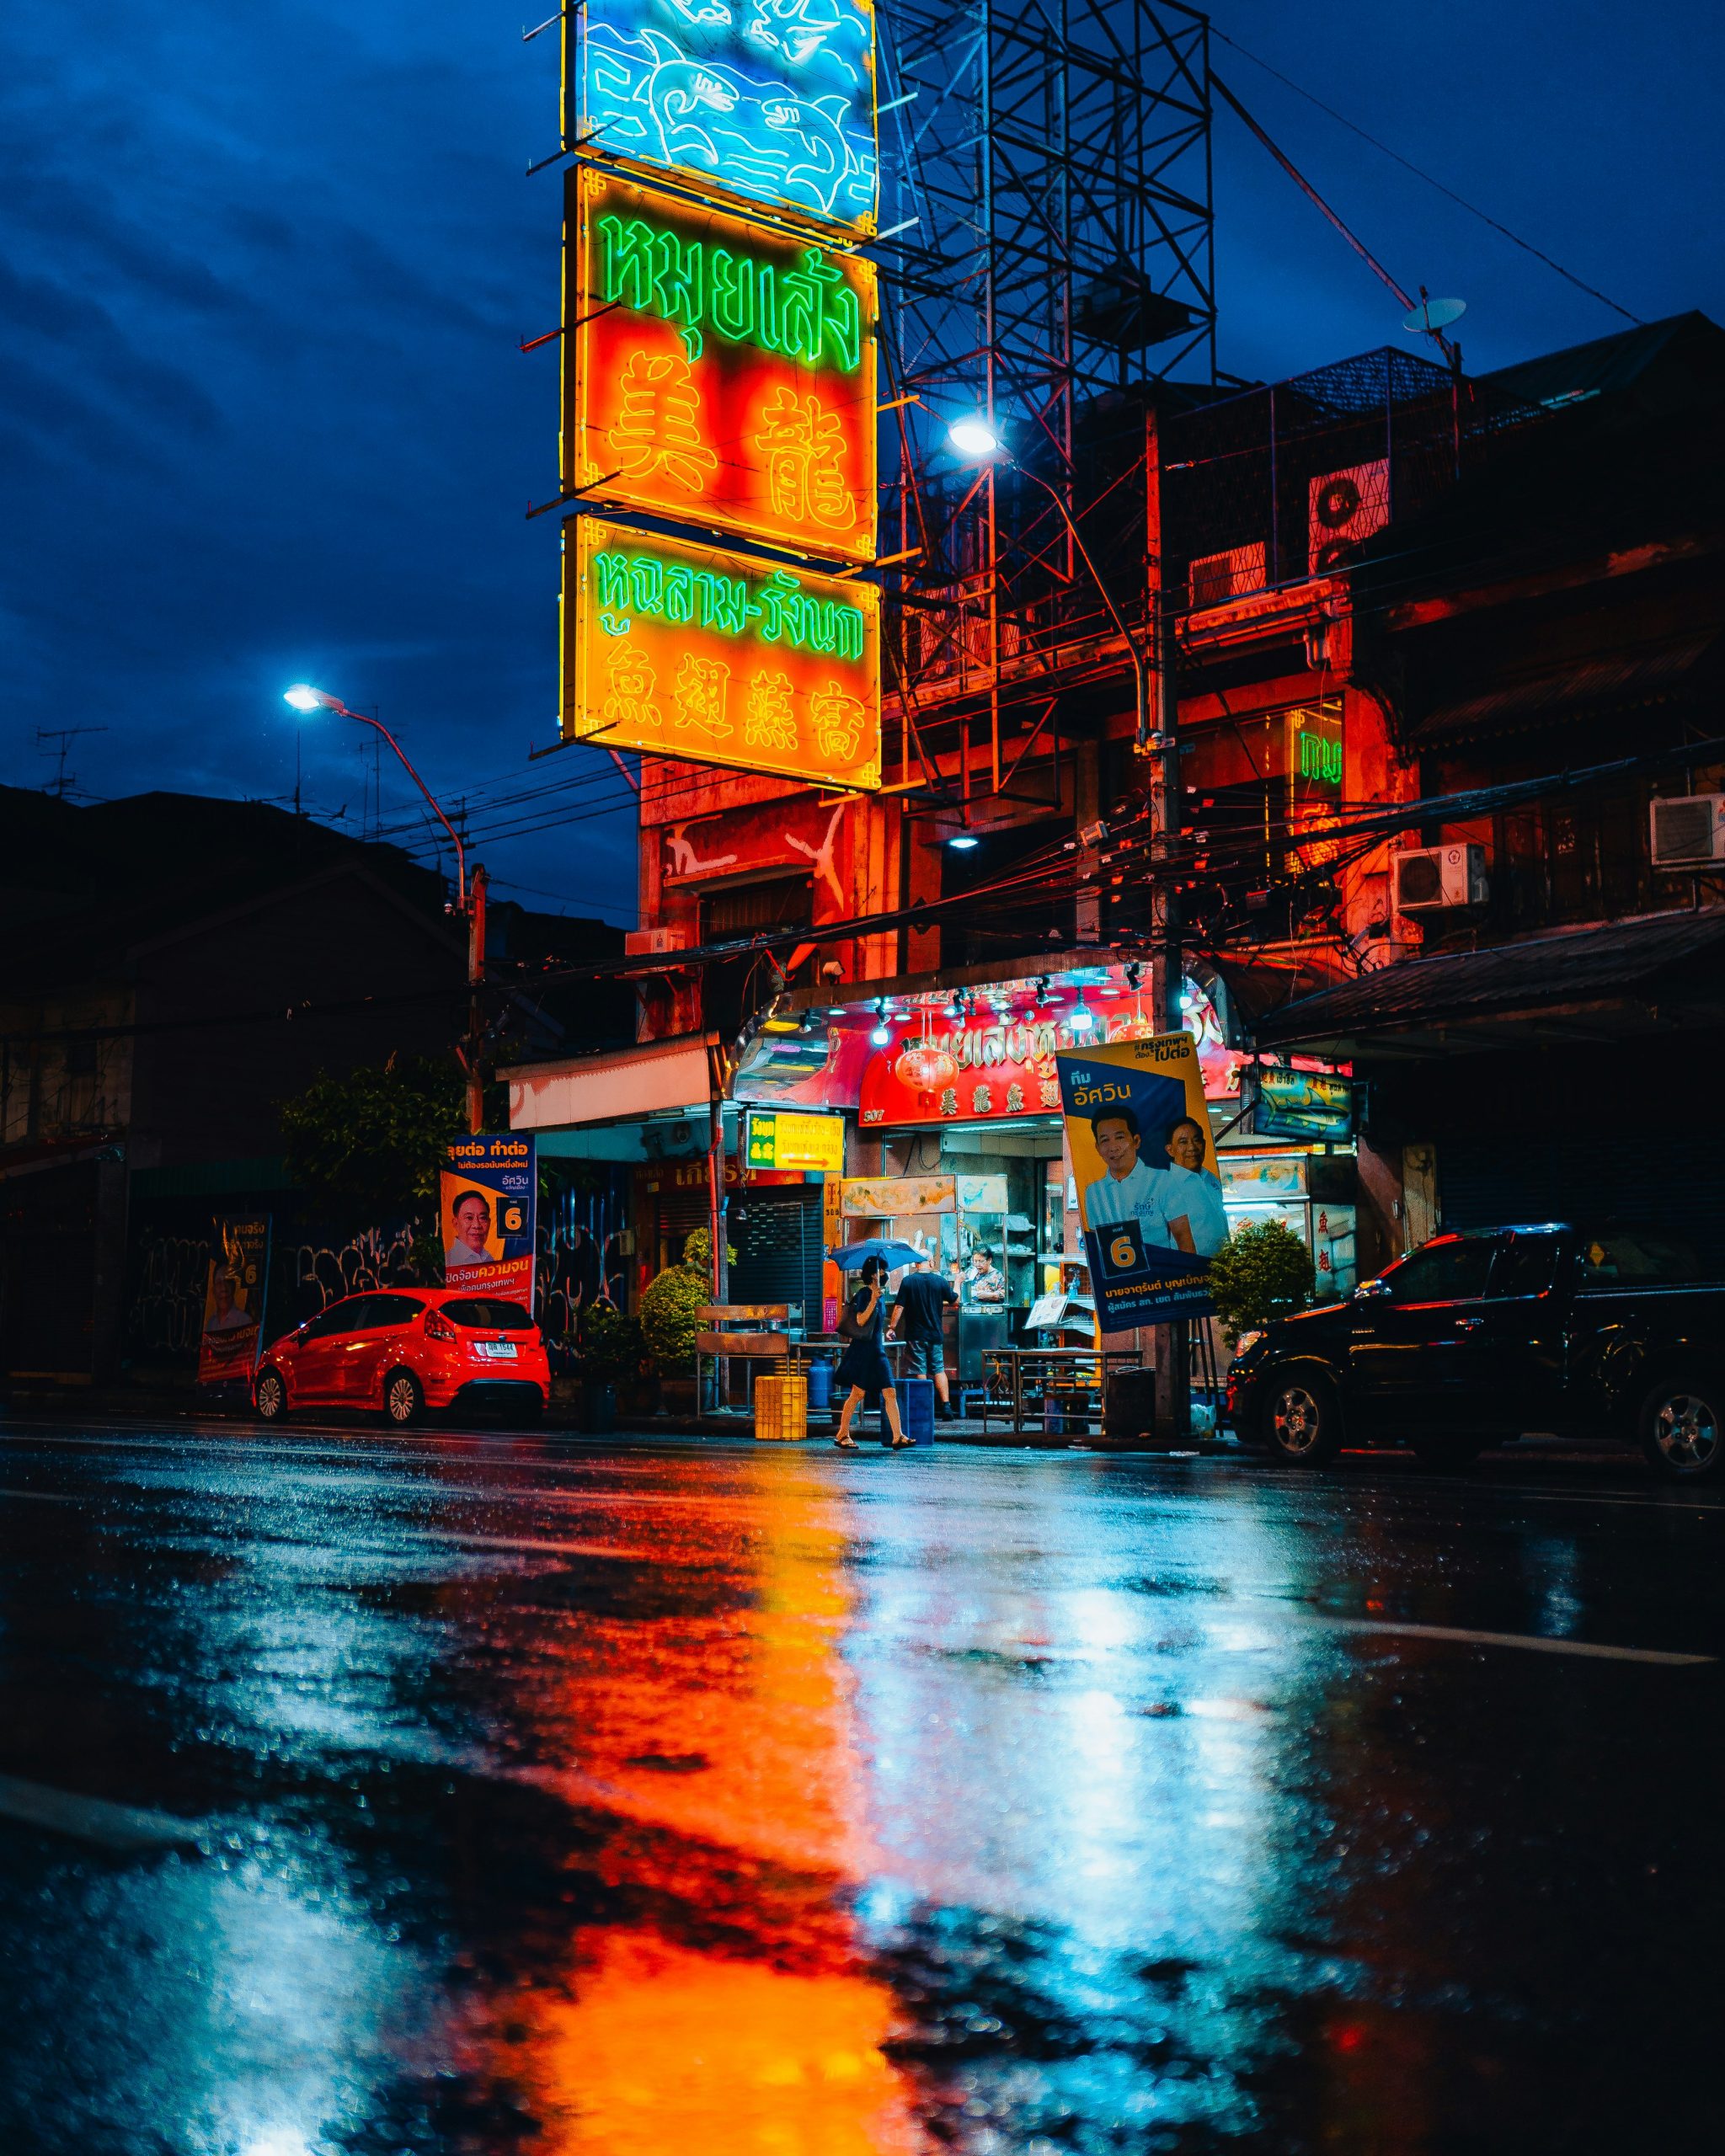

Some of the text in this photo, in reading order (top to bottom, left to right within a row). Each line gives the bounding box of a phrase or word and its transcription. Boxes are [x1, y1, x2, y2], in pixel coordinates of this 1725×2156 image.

[597, 215, 861, 371] หมุยเล้ง
[607, 350, 857, 530] 美龍
[594, 552, 864, 661] หูฉลาม-รังนก
[603, 639, 866, 761] 魚翅燕窩
[1070, 1071, 1092, 1086] ทีม
[1073, 1082, 1132, 1106] อัศวิน
[862, 1110, 884, 1123] 507
[446, 1139, 528, 1161] ลุยต่อ ทำต่อ
[457, 1159, 528, 1169] ไม่ต้องรอนับหนึ่งใหม่
[502, 1175, 529, 1185] อัศวิน
[505, 1207, 522, 1230] 6
[1110, 1236, 1136, 1268] 6
[245, 1263, 257, 1285] 6
[1156, 1295, 1171, 1304] เขต
